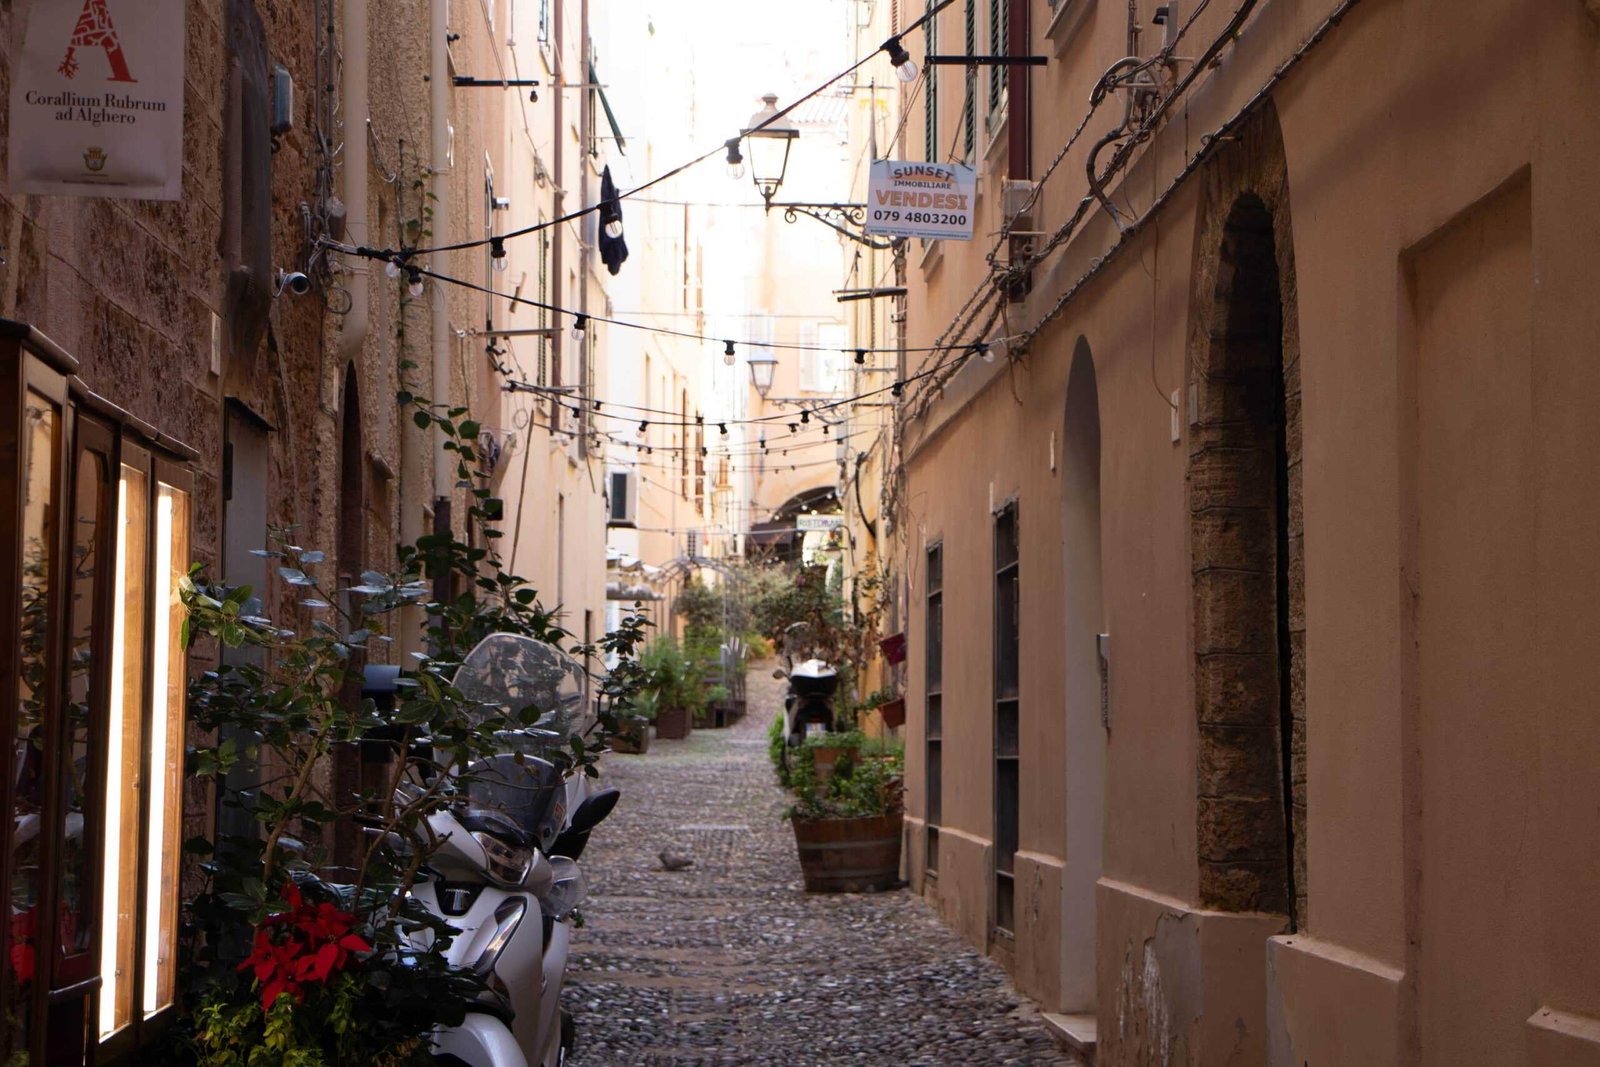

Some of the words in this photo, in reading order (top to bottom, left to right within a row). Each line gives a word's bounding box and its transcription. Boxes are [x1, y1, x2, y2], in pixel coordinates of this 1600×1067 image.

[25, 90, 101, 107] Corallium
[104, 93, 166, 112] Rubrum
[55, 107, 73, 121] ad
[76, 107, 136, 127] Alghero
[893, 165, 955, 182] SUNSET
[893, 180, 952, 190] IMMOBILIARE
[875, 189, 968, 211] VENDESI
[873, 210, 900, 222] 079
[904, 212, 967, 225] 4803200
